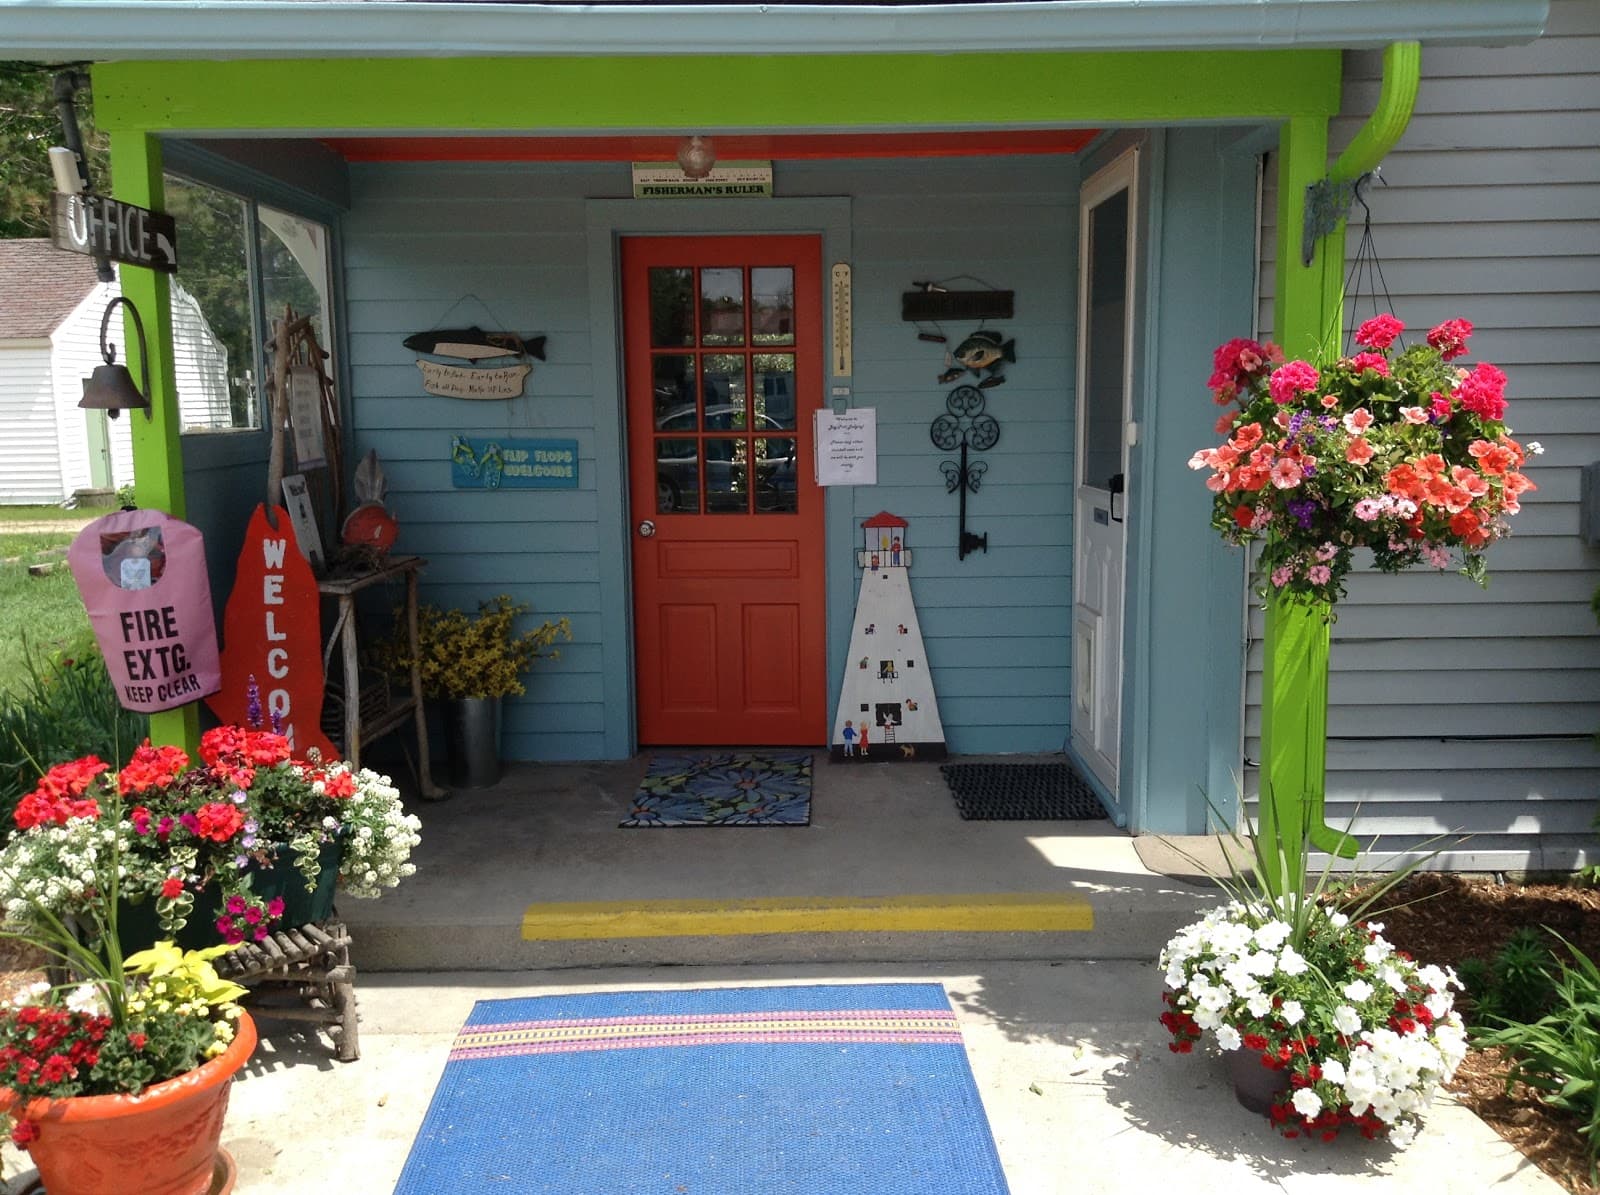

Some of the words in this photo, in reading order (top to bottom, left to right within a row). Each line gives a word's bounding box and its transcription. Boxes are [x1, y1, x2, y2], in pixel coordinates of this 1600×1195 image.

[643, 186, 722, 195] FISHERMAN'S
[726, 185, 764, 194] RULER
[67, 195, 152, 261] OFFICE
[503, 449, 529, 462] FLIP
[534, 450, 573, 463] FLOPS
[503, 464, 573, 477] WELCOME
[120, 606, 178, 642] FIRE
[123, 643, 192, 681] EXTG.
[125, 684, 154, 704] KEEP
[157, 675, 201, 702] CLEAR
